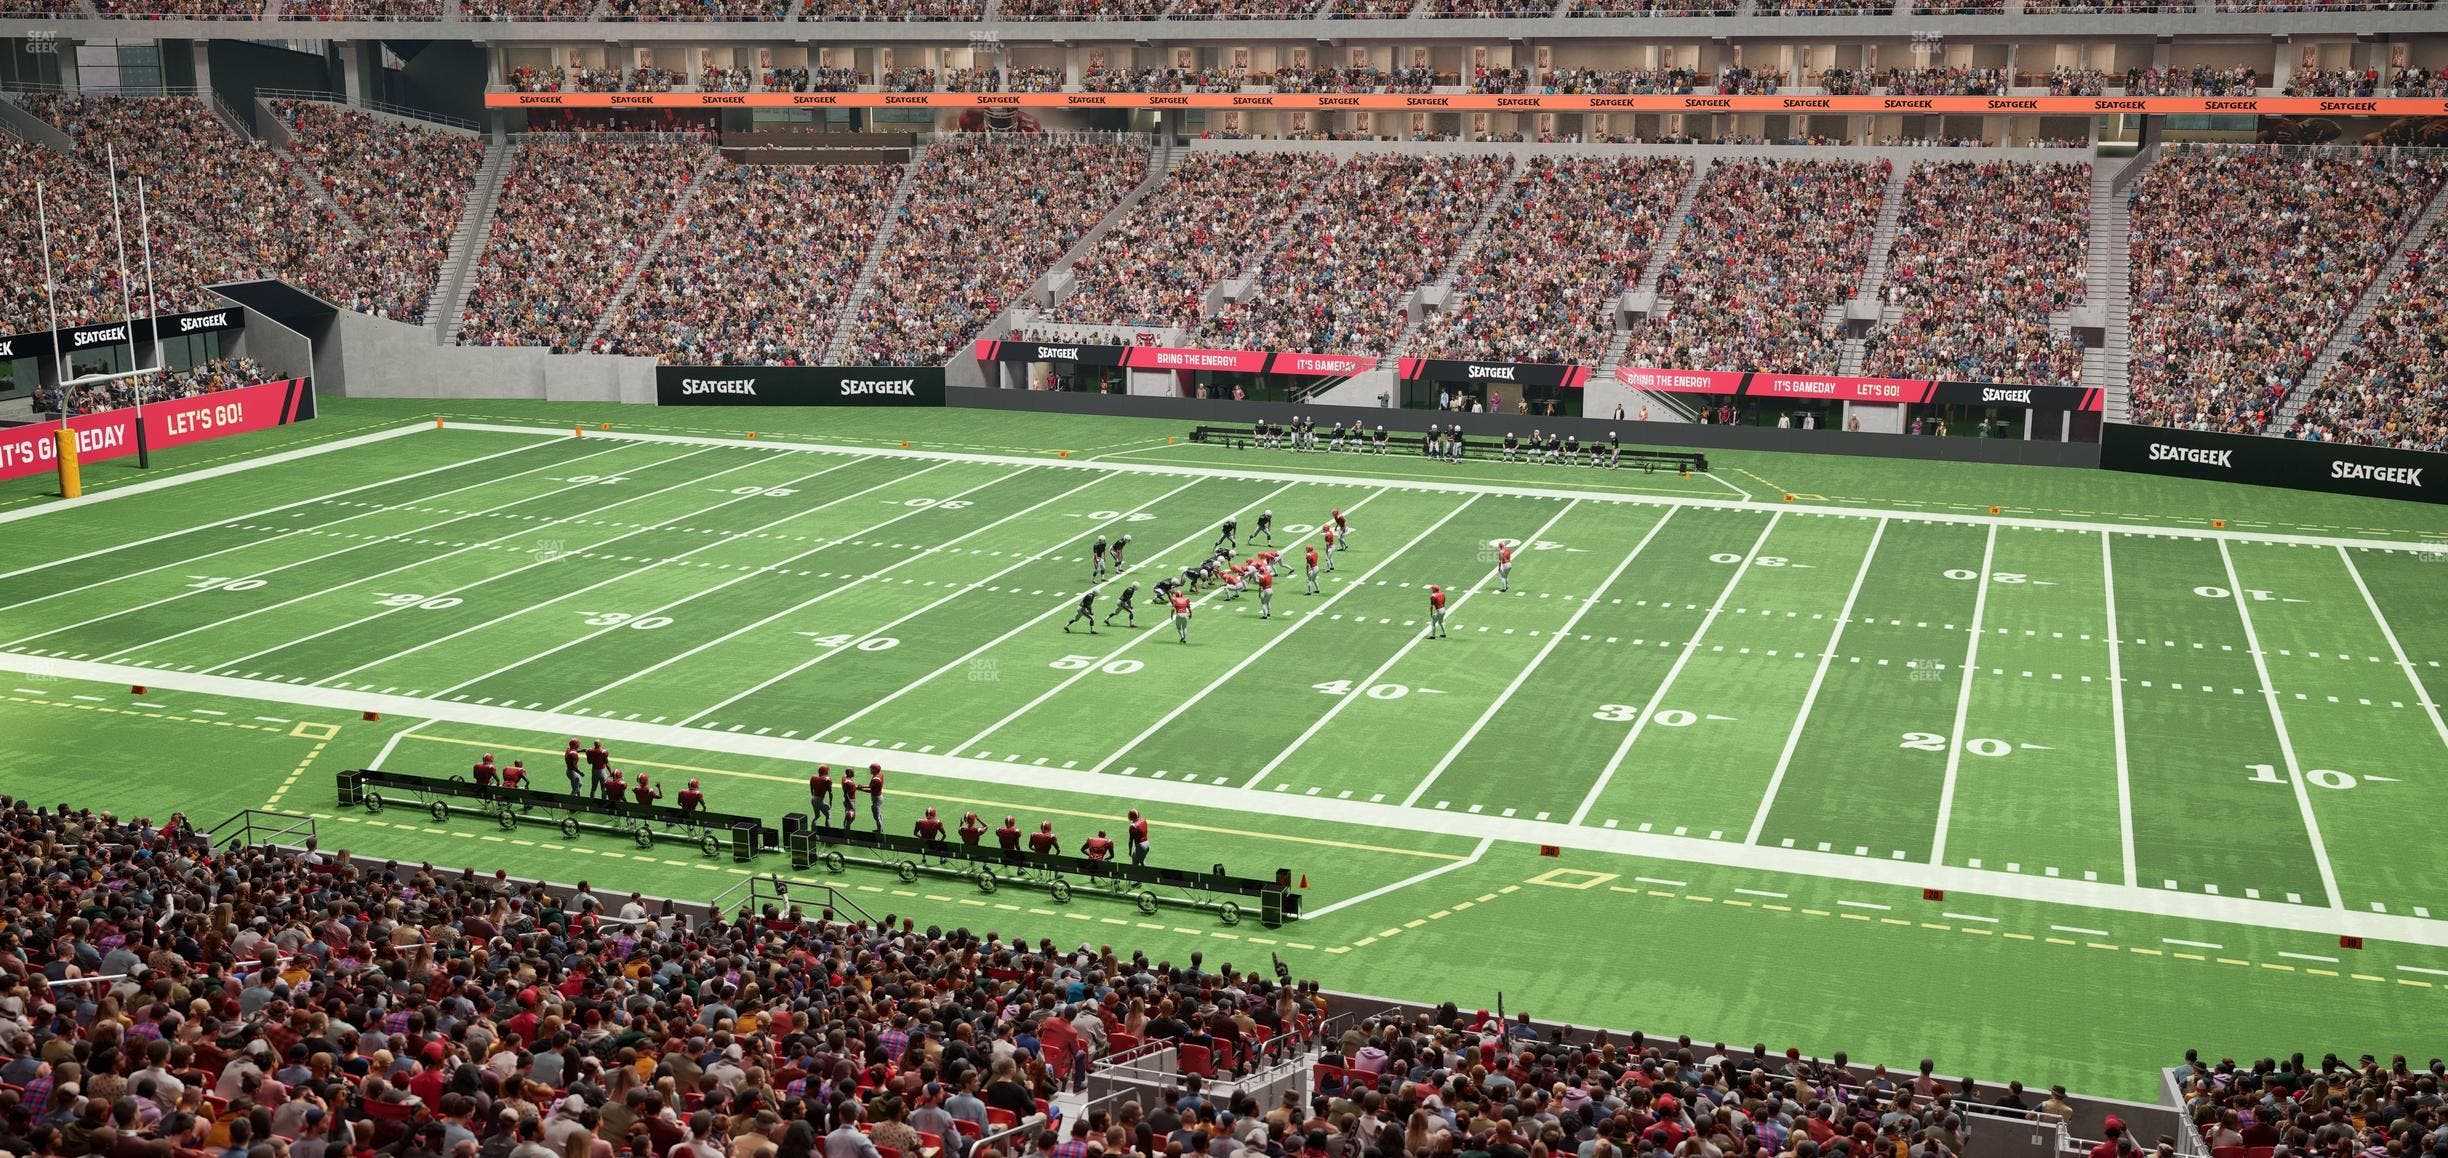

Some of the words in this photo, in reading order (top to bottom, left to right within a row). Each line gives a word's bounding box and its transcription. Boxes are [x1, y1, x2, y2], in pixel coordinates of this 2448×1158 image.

[519, 95, 562, 104] SEATGEEK
[610, 95, 654, 104] SEATGEEK
[702, 95, 745, 104] SEATGEEK
[793, 95, 837, 104] SEATGEEK
[885, 95, 929, 104] SEATGEEK
[977, 95, 1020, 104] SEATGEEK
[1067, 96, 1106, 104] SEATGEEK
[1149, 96, 1189, 105] SEATGEEK
[1233, 96, 1273, 105] SEATGEEK
[1318, 97, 1360, 106] SEATGEEK
[1406, 97, 1449, 106] SEATGEEK
[1497, 98, 1541, 107] SEATGEEK
[1589, 98, 1634, 107] SEATGEEK
[1686, 98, 1731, 108] SEATGEEK
[1783, 99, 1830, 108] SEATGEEK
[1884, 99, 1933, 109] SEATGEEK
[1987, 99, 2038, 109] SEATGEEK
[2094, 100, 2146, 110] SEATGEEK
[2204, 100, 2258, 111] SEATGEEK
[2319, 101, 2377, 112] SEATGEEK
[180, 312, 228, 332] SEATGEEK
[74, 326, 126, 347] SEATGEEK
[1038, 347, 1079, 361] SEATGEEK
[1157, 353, 1183, 364] BRING
[1184, 354, 1200, 365] THE
[1201, 354, 1237, 367] ENERGY!
[1297, 359, 1313, 370] IT'S
[1468, 365, 1515, 380] SEATGEEK
[683, 379, 756, 396] SEATGEEK
[841, 379, 915, 396] SEATGEEK
[1656, 375, 1672, 387] THE
[1673, 376, 1712, 389] ENERGY!
[1774, 380, 1791, 392] IT'S
[1792, 381, 1836, 394] GAMEDAY
[1857, 383, 1882, 395] LET'S
[1883, 385, 1900, 397] GO!
[1983, 387, 2032, 404] SEATGEEK
[167, 408, 212, 436] LET'S
[215, 402, 244, 426] GO!
[38, 426, 125, 461] GEDAY
[2149, 443, 2233, 467] SEATGEEK
[2332, 460, 2423, 487] SEATGEEK
[1048, 654, 1145, 675] 50
[1311, 679, 1410, 700] 40
[1592, 703, 1698, 728] 30
[1899, 732, 2012, 757] 20
[2245, 763, 2358, 789] 10
